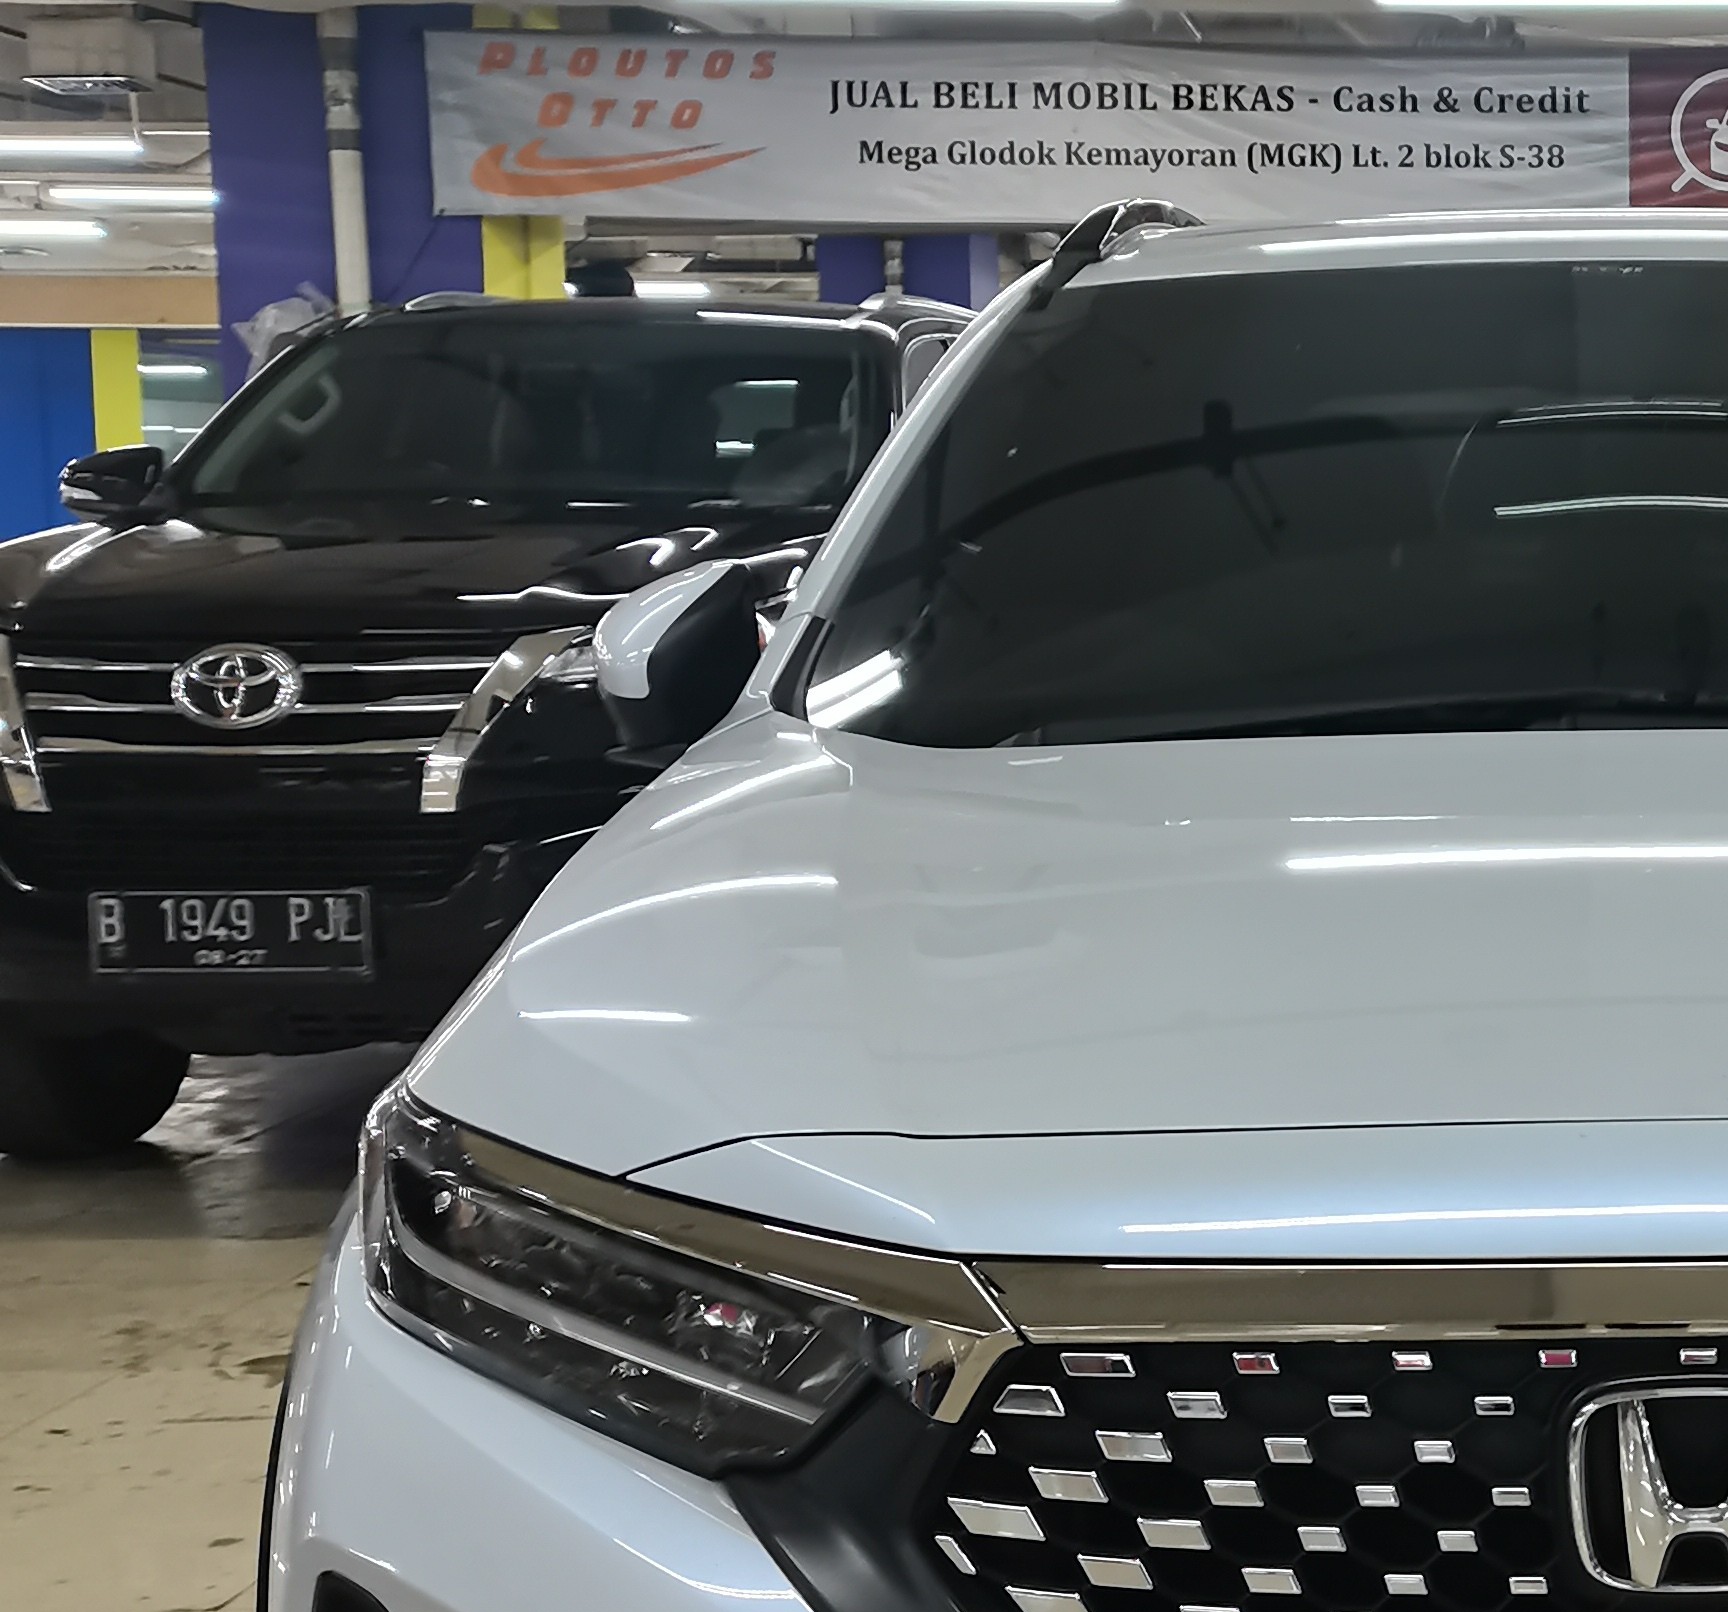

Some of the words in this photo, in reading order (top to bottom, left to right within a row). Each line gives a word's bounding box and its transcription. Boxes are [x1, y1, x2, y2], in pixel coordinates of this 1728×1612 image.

[477, 41, 777, 81] PLOUTOS
[536, 91, 705, 130] OTTO
[829, 79, 919, 114] JUAL
[932, 80, 1019, 111] BELI
[1031, 81, 1159, 112] MOBIL
[1171, 83, 1296, 114] BEKAS
[1332, 84, 1420, 115] Cash
[1432, 86, 1461, 115] &
[1472, 84, 1591, 115] Credit
[858, 139, 939, 173] Mega
[947, 139, 1055, 168] Glodok
[1064, 140, 1238, 173] Kemayoran
[1247, 142, 1342, 174] (MGK)
[1351, 143, 1389, 169] Lt.
[1397, 144, 1414, 169] 2
[1425, 142, 1492, 169] blok
[1498, 143, 1565, 170] S-38
[97, 897, 126, 944] B
[158, 897, 256, 943] 1949
